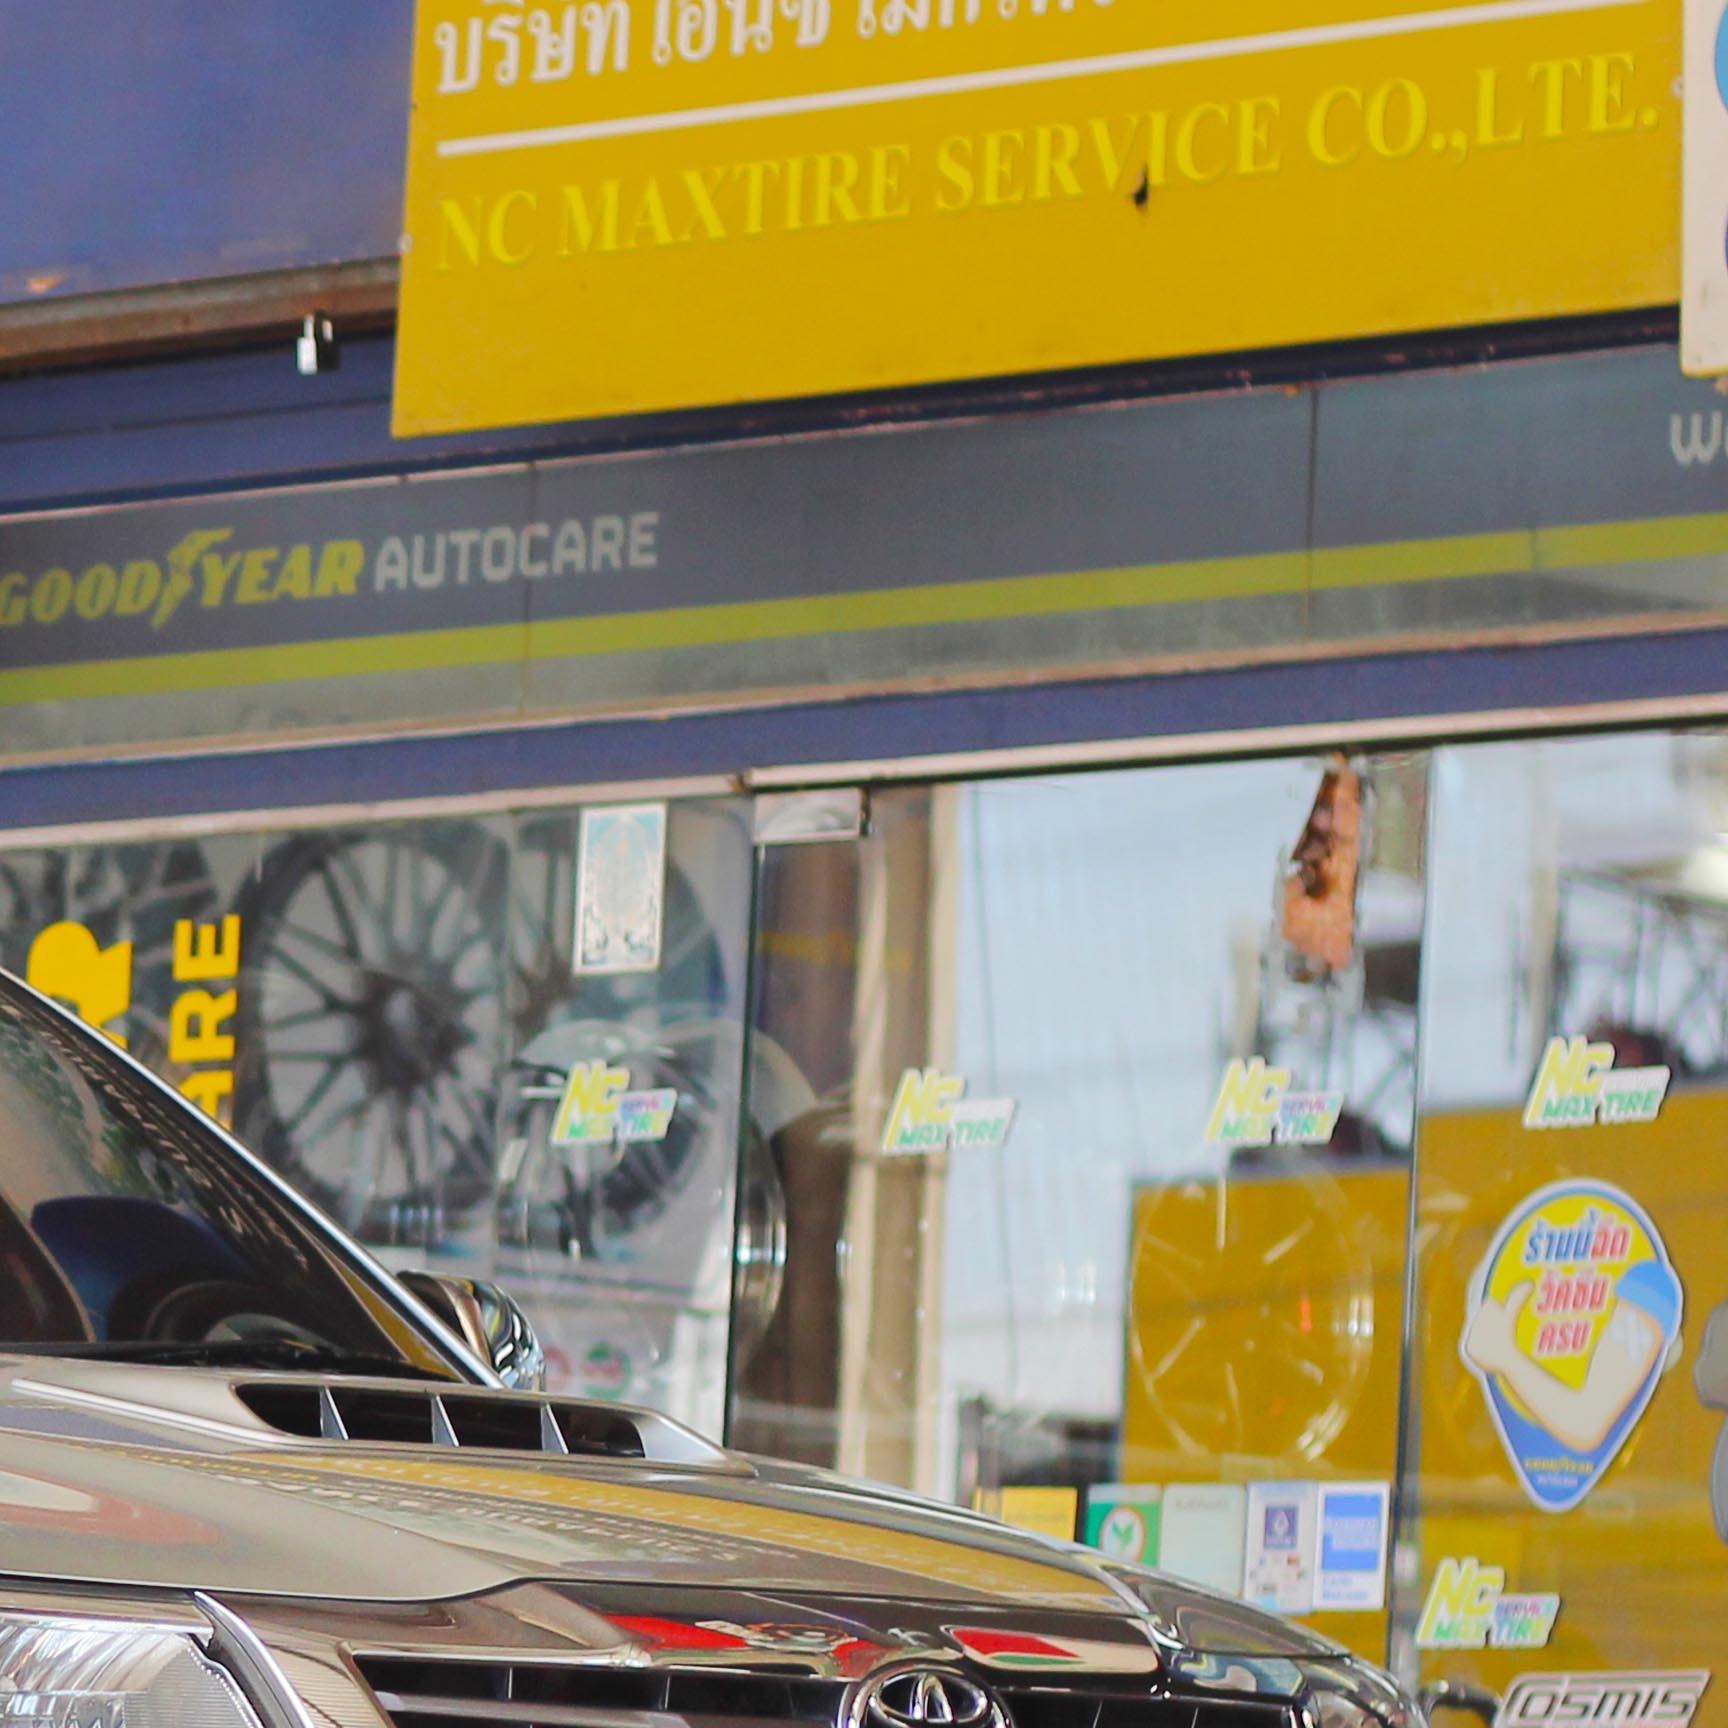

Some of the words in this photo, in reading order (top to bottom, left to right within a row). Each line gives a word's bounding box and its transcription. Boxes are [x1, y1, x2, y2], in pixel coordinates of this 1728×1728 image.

[434, 189, 539, 271] NC
[558, 143, 911, 256] MAXTIRE
[934, 96, 1282, 217] SERVICE
[374, 512, 660, 592] AUTOCARE
[554, 1062, 625, 1139] NC
[887, 1069, 964, 1147] NC
[1206, 1060, 1289, 1139] NC
[1526, 1038, 1614, 1122] NC
[1603, 1088, 1660, 1115] TIRE
[1420, 1563, 1504, 1641] NC
